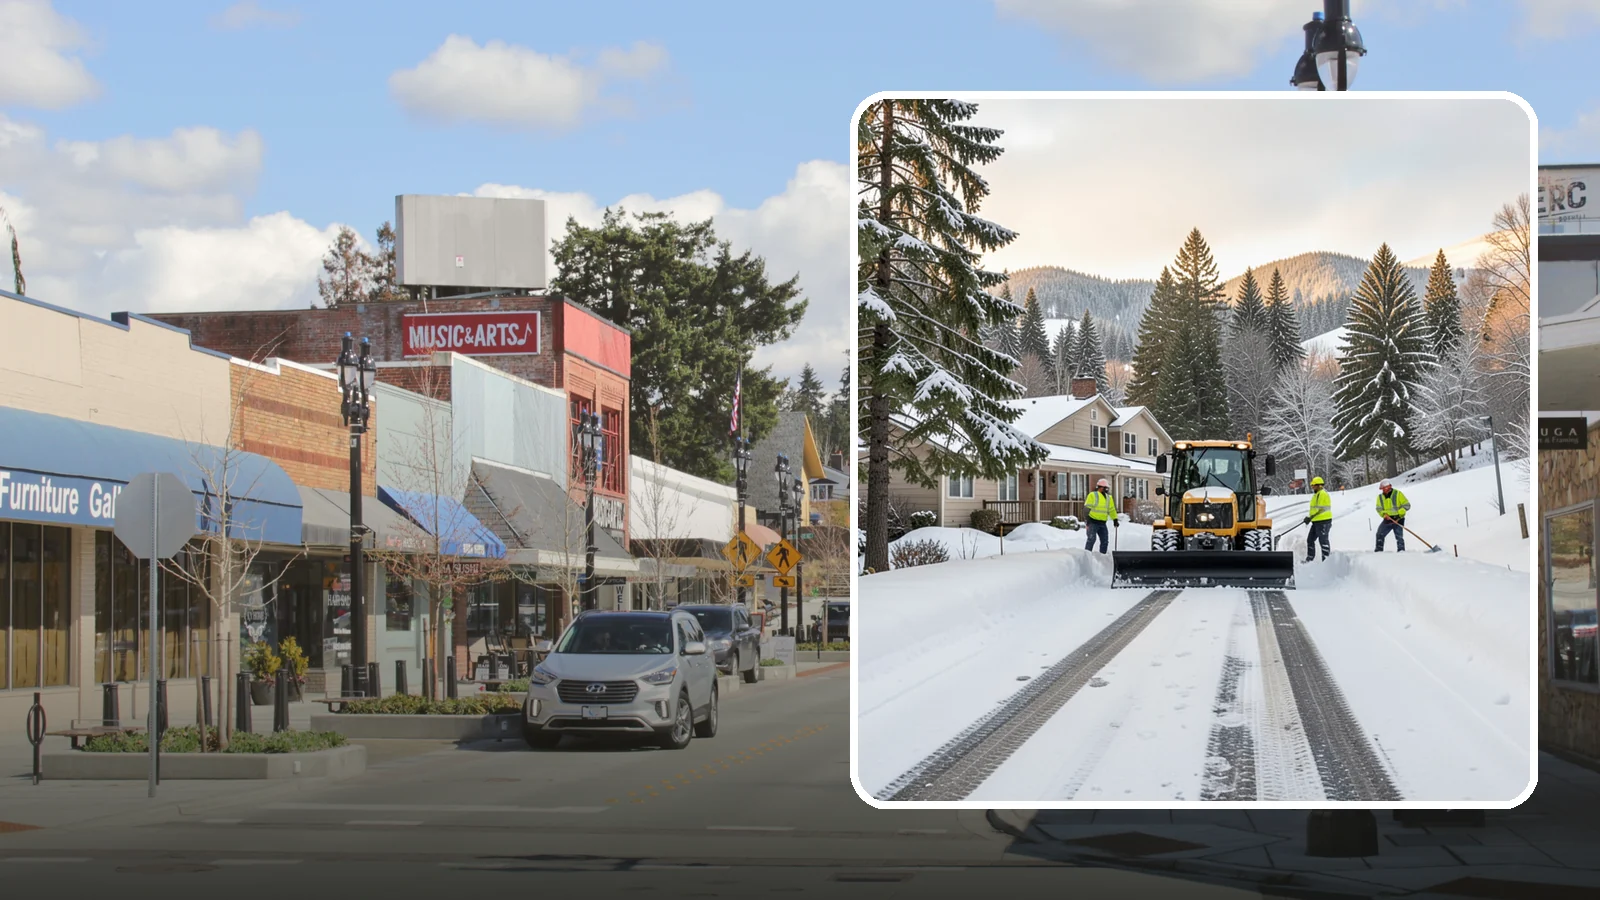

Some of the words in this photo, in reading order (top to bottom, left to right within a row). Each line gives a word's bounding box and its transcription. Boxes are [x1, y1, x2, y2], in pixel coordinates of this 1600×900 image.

[1538, 181, 1586, 213] ERC
[409, 323, 519, 348] MUSIC&ARTS
[1540, 427, 1577, 436] UGA
[0, 471, 79, 515] Furniture
[89, 482, 121, 518] Gal
[453, 563, 479, 574] SUSHI
